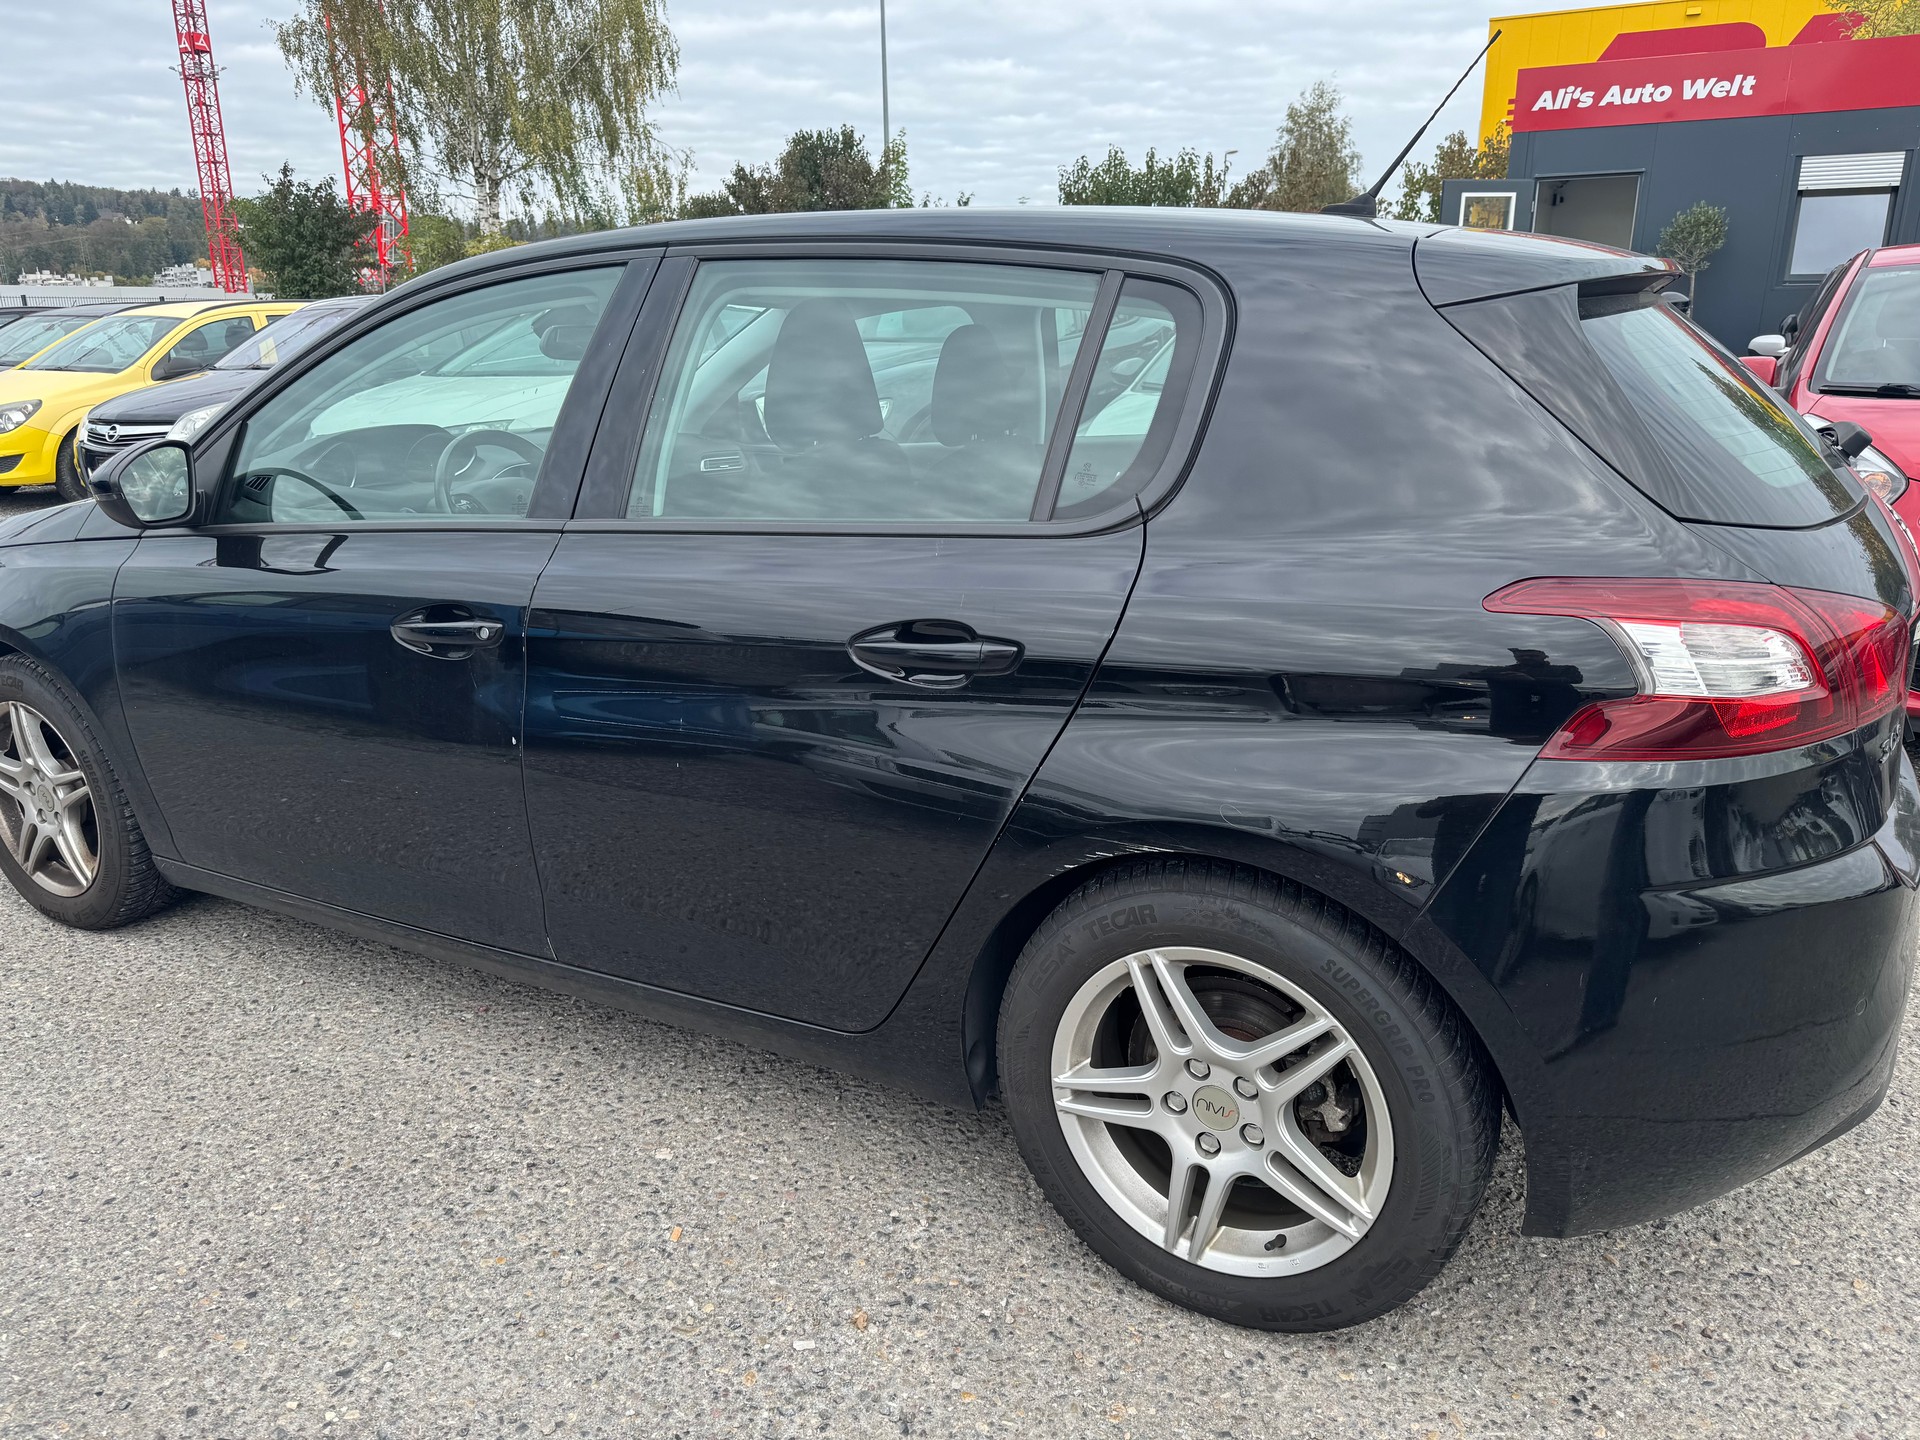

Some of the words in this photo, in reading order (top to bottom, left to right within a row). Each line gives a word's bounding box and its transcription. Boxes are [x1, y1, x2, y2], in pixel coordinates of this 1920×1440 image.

[1531, 86, 1595, 111] Ali's
[1598, 84, 1672, 107] Auto
[1682, 74, 1757, 101] Welt
[79, 749, 108, 813] SUPERGRIP
[103, 817, 114, 839] PRO
[1082, 904, 1158, 941] TECAR
[1320, 959, 1414, 1056] SUPERGRIP
[1406, 1065, 1435, 1103] PRO
[1258, 1299, 1342, 1322] TECAR
